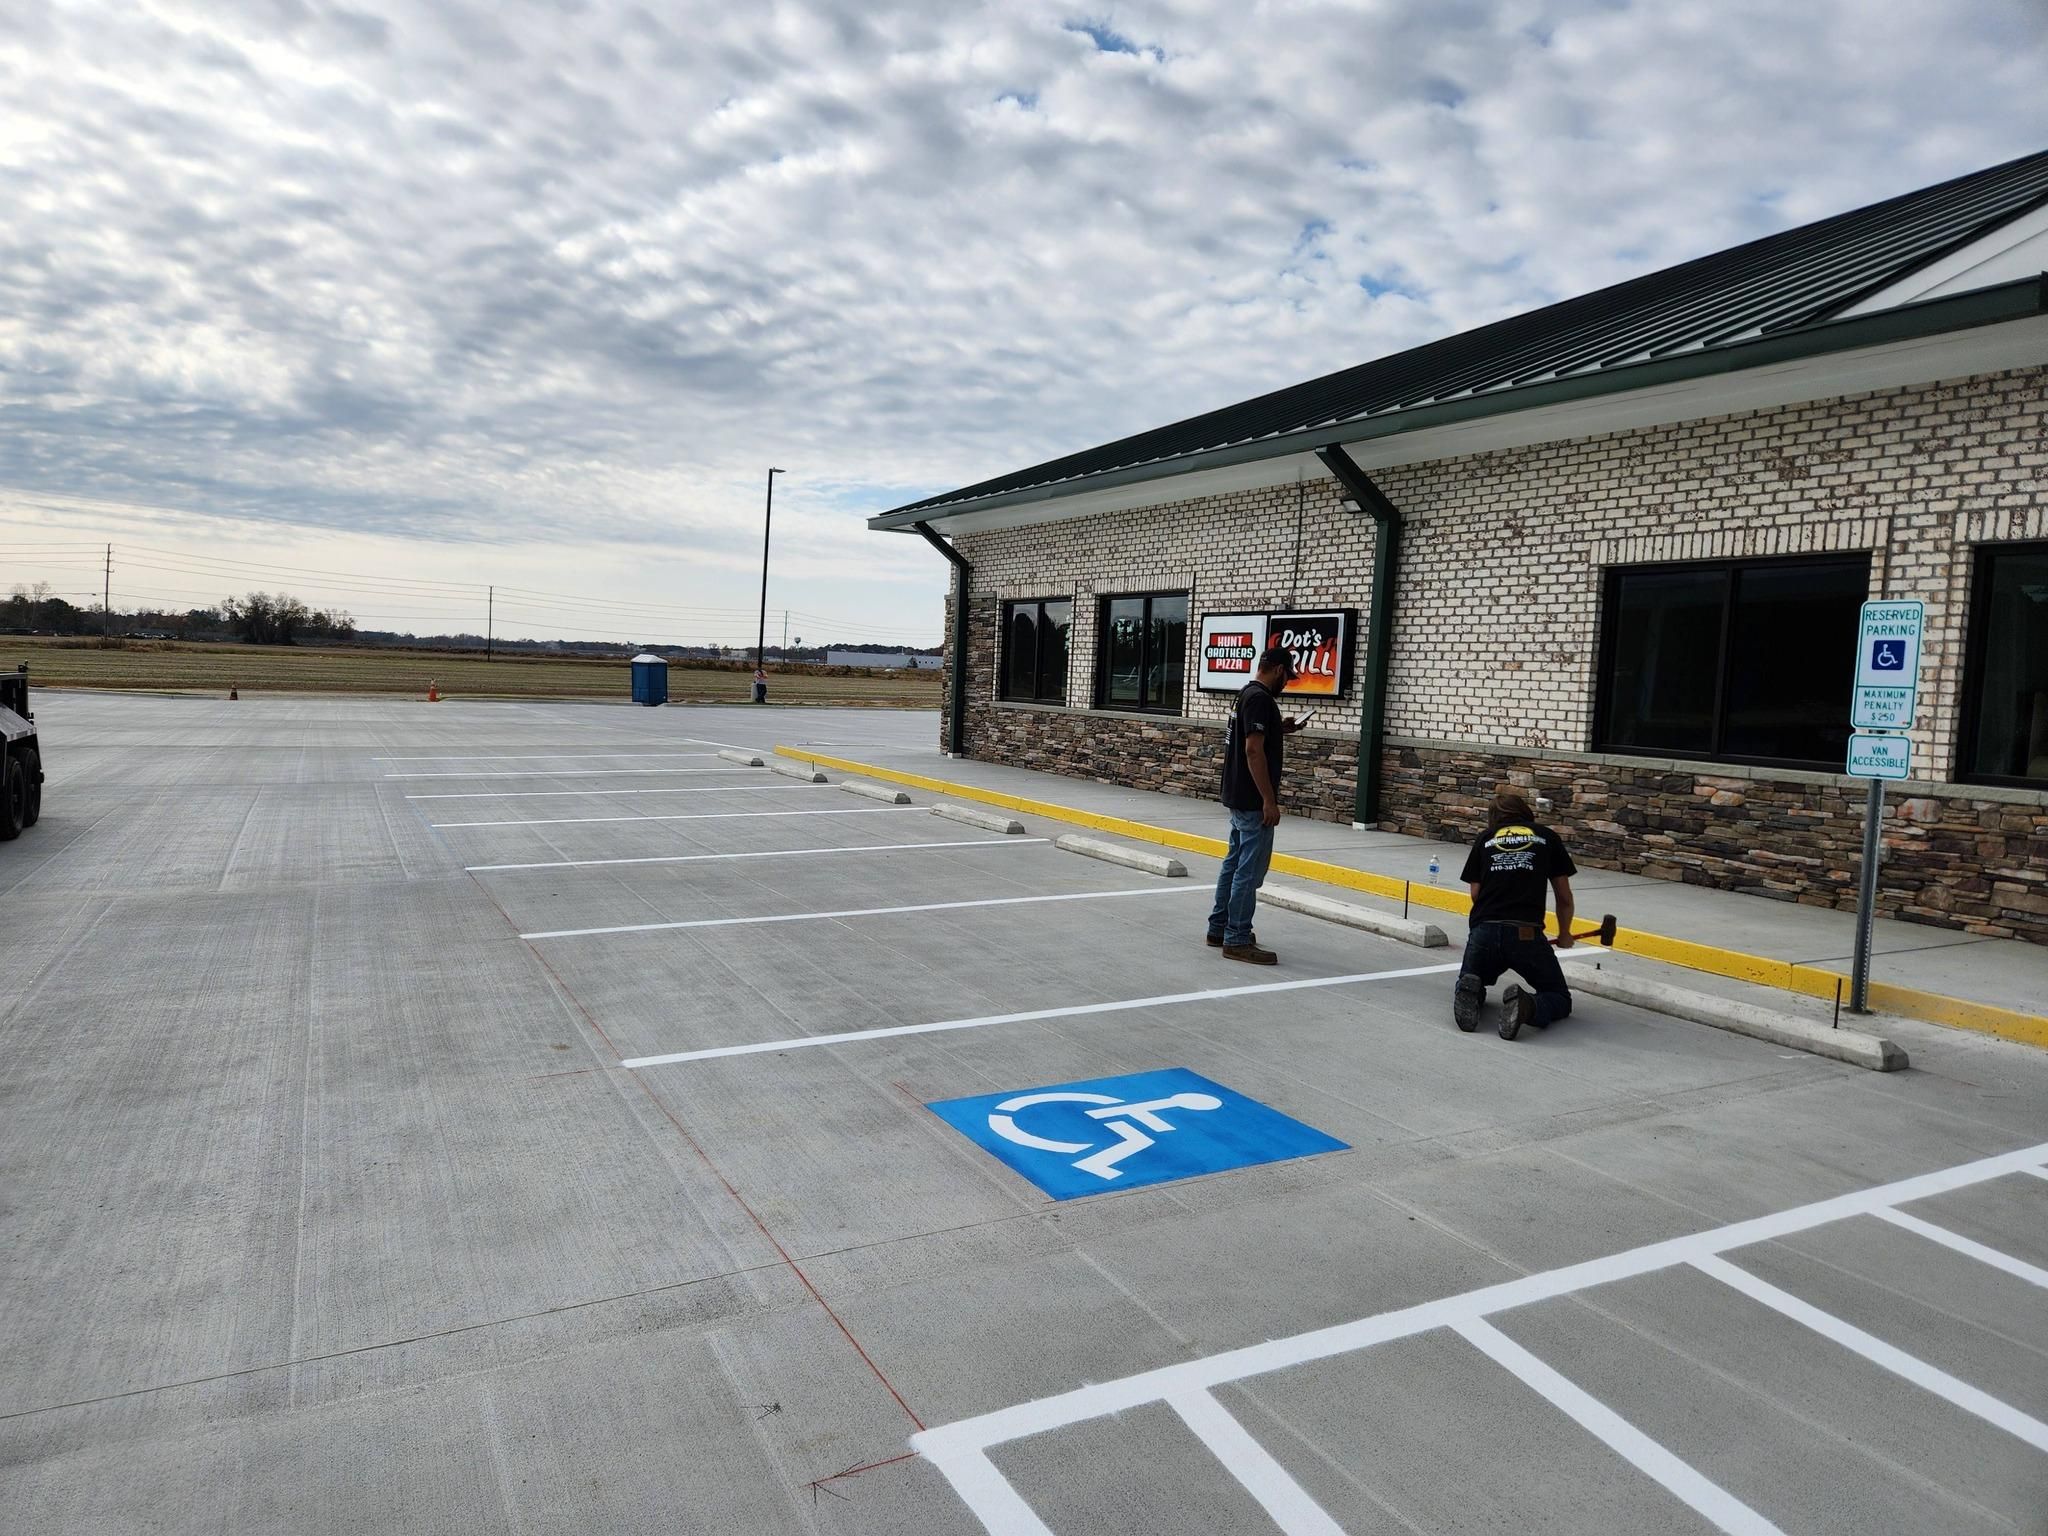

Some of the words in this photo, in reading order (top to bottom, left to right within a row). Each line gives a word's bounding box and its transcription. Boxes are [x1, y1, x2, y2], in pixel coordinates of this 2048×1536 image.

[1865, 609, 1920, 621] RESERVED
[1866, 624, 1916, 636] PARKING
[1217, 635, 1244, 648] HUNT
[1281, 628, 1323, 648] Dot's
[1207, 647, 1253, 659] BROTHERS
[1215, 658, 1243, 670] PIZZA
[1288, 650, 1334, 676] RILL
[1863, 690, 1906, 699] MAXIMUM
[1864, 701, 1904, 711] PENALTY
[1871, 746, 1888, 755] VAN
[1852, 756, 1905, 769] ACCESSIBLE
